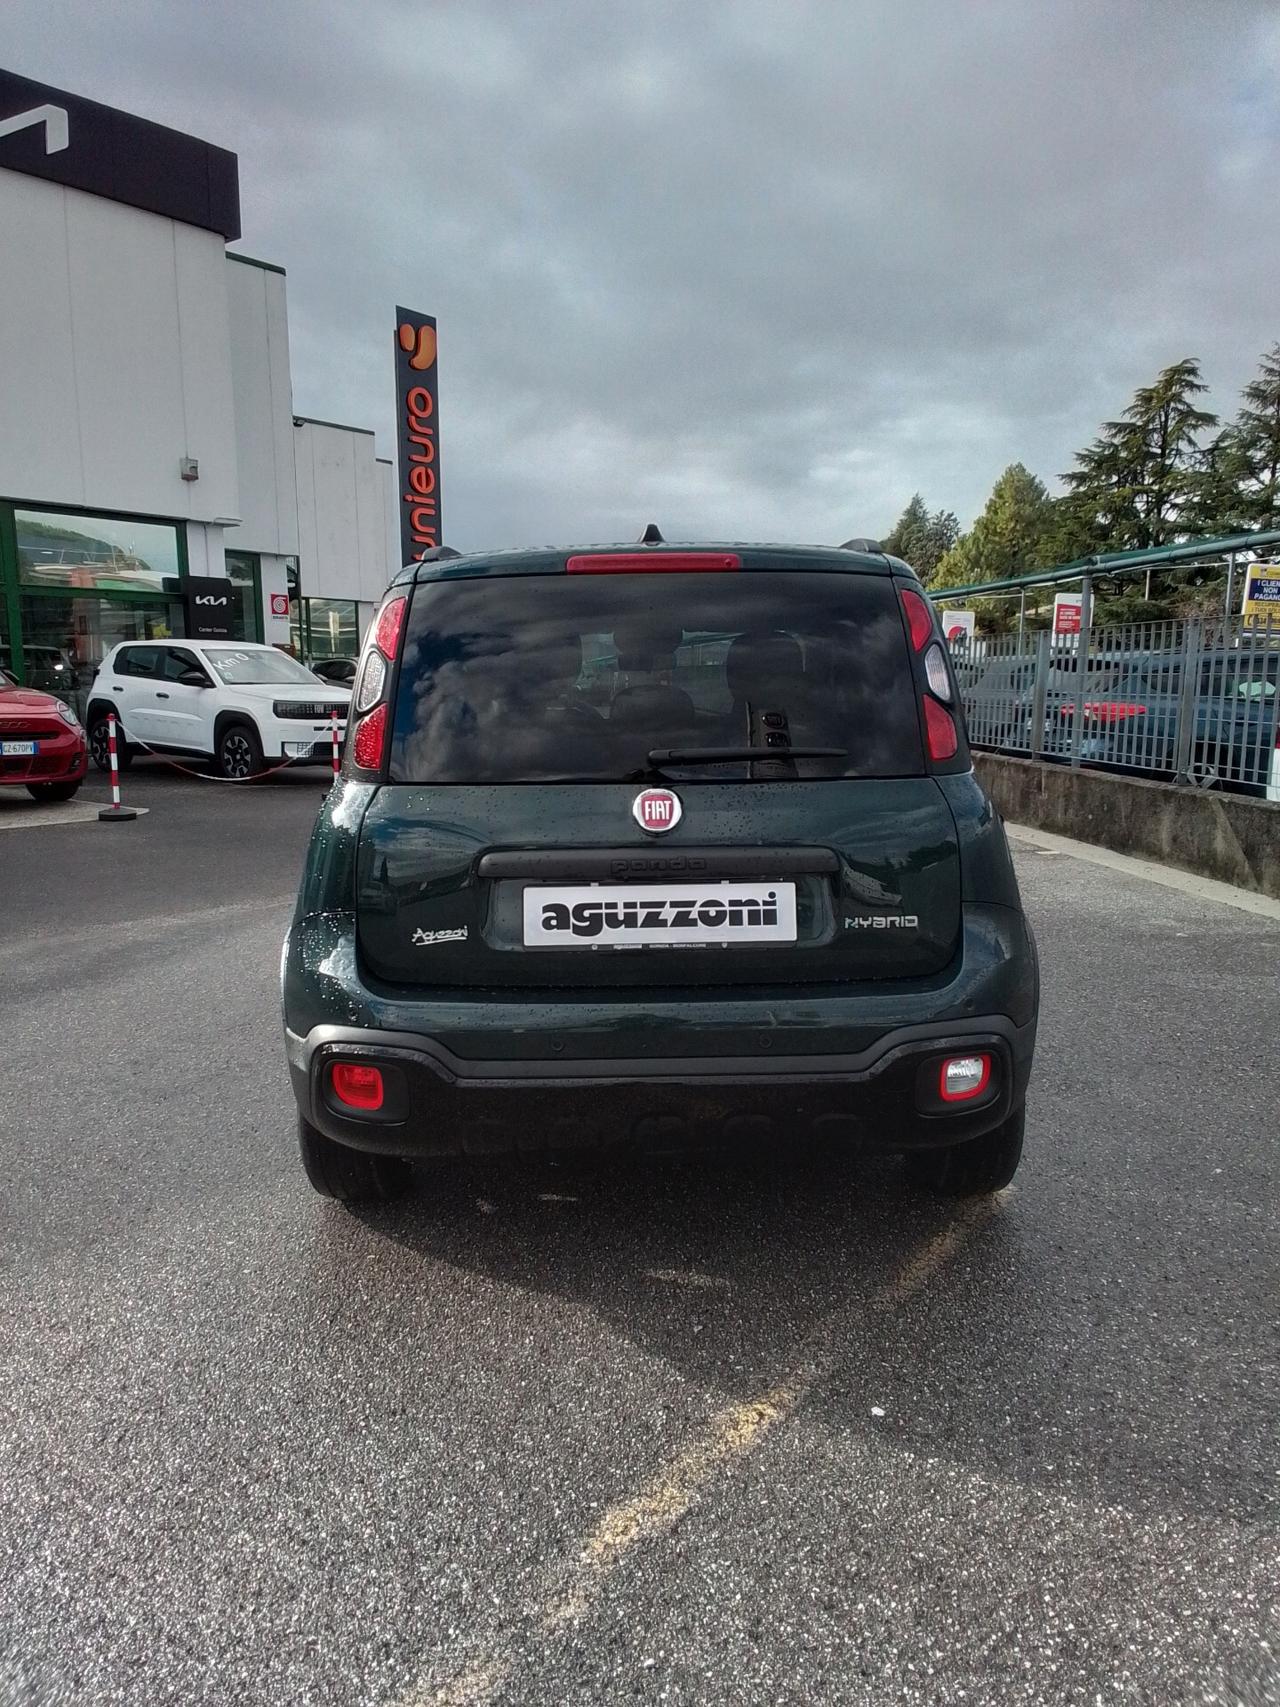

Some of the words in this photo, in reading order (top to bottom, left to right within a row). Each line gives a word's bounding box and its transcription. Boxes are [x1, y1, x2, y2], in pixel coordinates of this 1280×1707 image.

[404, 386, 437, 561] unieuro
[645, 800, 671, 820] FIAT
[611, 856, 706, 874] panda
[541, 891, 777, 937] aguzzoni
